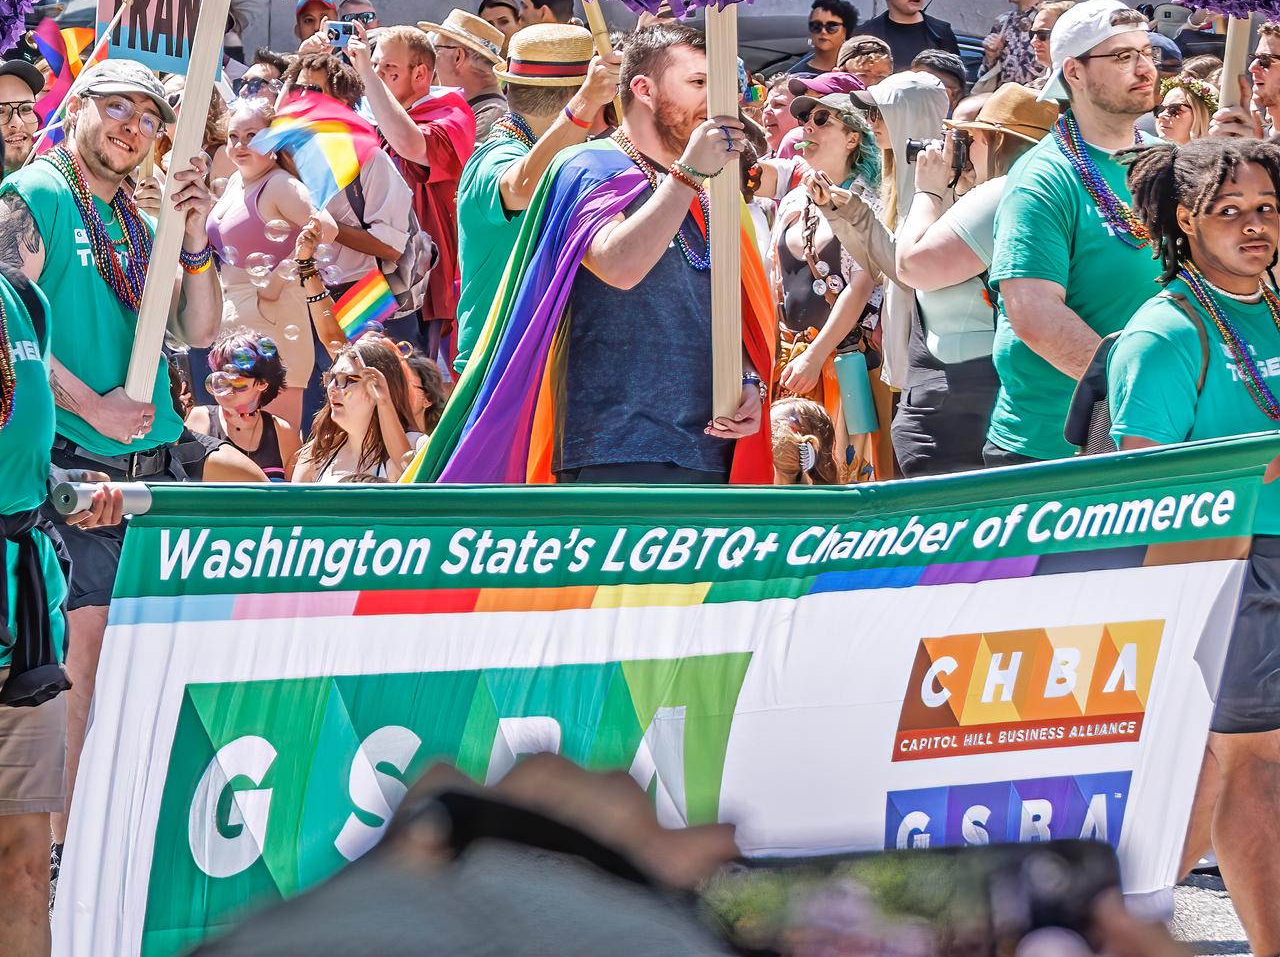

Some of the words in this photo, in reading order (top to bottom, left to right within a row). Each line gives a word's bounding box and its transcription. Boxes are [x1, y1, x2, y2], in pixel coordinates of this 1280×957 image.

[158, 525, 431, 587] Washington
[600, 526, 782, 573] LGBTQ+
[786, 516, 968, 566] Chamber
[973, 503, 1028, 550] of
[1028, 489, 1237, 542] Commerce
[920, 642, 1137, 709] CHBA
[900, 734, 959, 753] CAPITOL
[963, 731, 994, 747] HILL
[997, 725, 1065, 744] BUSINESS
[1068, 720, 1138, 739] ALLIANCE
